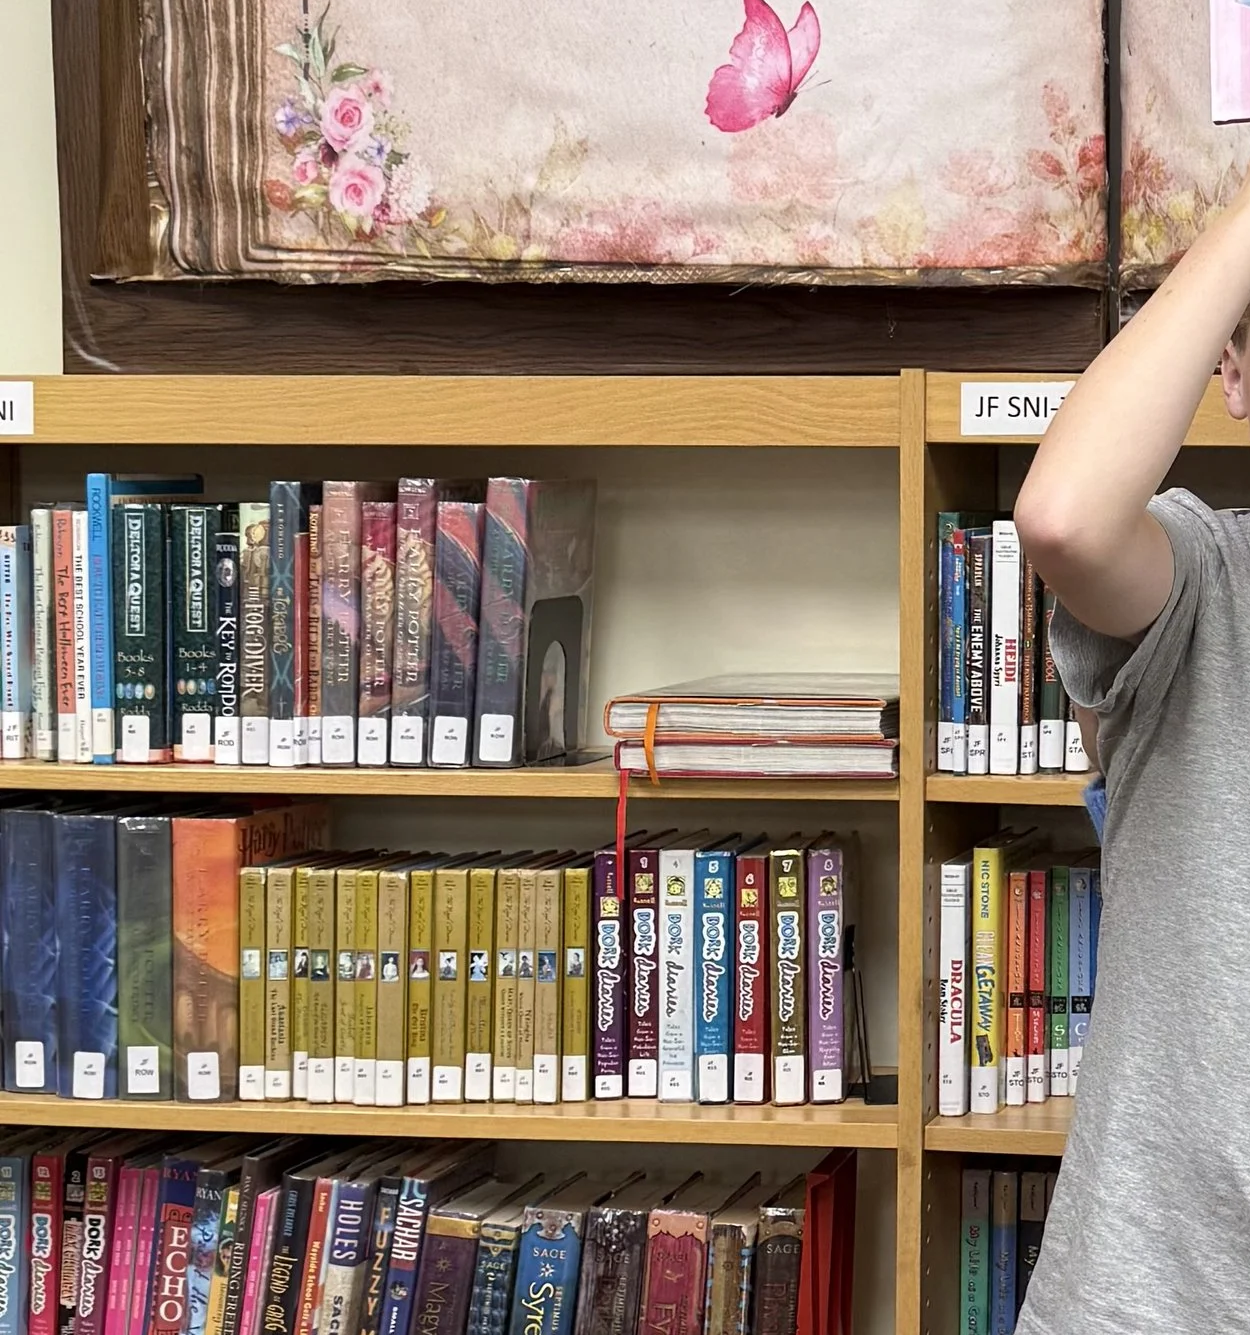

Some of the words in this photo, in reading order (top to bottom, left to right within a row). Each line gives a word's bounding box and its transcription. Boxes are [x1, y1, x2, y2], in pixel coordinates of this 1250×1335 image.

[975, 396, 1000, 418] JF
[1008, 396, 1065, 418] SNI-
[129, 517, 142, 581] DELTORA
[191, 514, 203, 577] DELTORA
[128, 584, 143, 631] QUEST
[192, 578, 205, 628] QUEST
[178, 647, 216, 659] Books
[217, 616, 237, 651] KEY
[970, 625, 984, 672] ENEMY
[117, 650, 154, 664] Books
[1004, 638, 1017, 683] HEIDI
[970, 673, 984, 714] ABOVE
[970, 748, 985, 757] SPR
[1068, 745, 1084, 754] STA
[708, 861, 720, 873] 5
[782, 861, 793, 872] 7
[981, 860, 990, 881] NIC
[980, 882, 989, 919] STONE
[600, 923, 617, 966] DORK
[636, 911, 653, 955] DORK
[667, 913, 684, 956] DORK
[706, 915, 721, 958] DORK
[741, 923, 756, 961] DORK
[781, 914, 796, 956] DORK
[820, 913, 837, 956] DORK
[950, 959, 963, 1044] DRACULA
[975, 964, 996, 1032] GETAWAY
[135, 1068, 155, 1077] ROW
[71, 1170, 80, 1183] 2
[33, 1214, 51, 1257] DORK
[83, 1215, 105, 1260] DORK
[332, 1199, 364, 1260] HOLES
[391, 1196, 424, 1262] SACHAR
[766, 1244, 801, 1254] SAGE
[158, 1225, 189, 1322] ECHO
[229, 1242, 245, 1293] RIDING
[270, 1253, 298, 1294] LEGEND
[366, 1207, 395, 1317] FUZZY
[532, 1247, 567, 1260] SAGE
